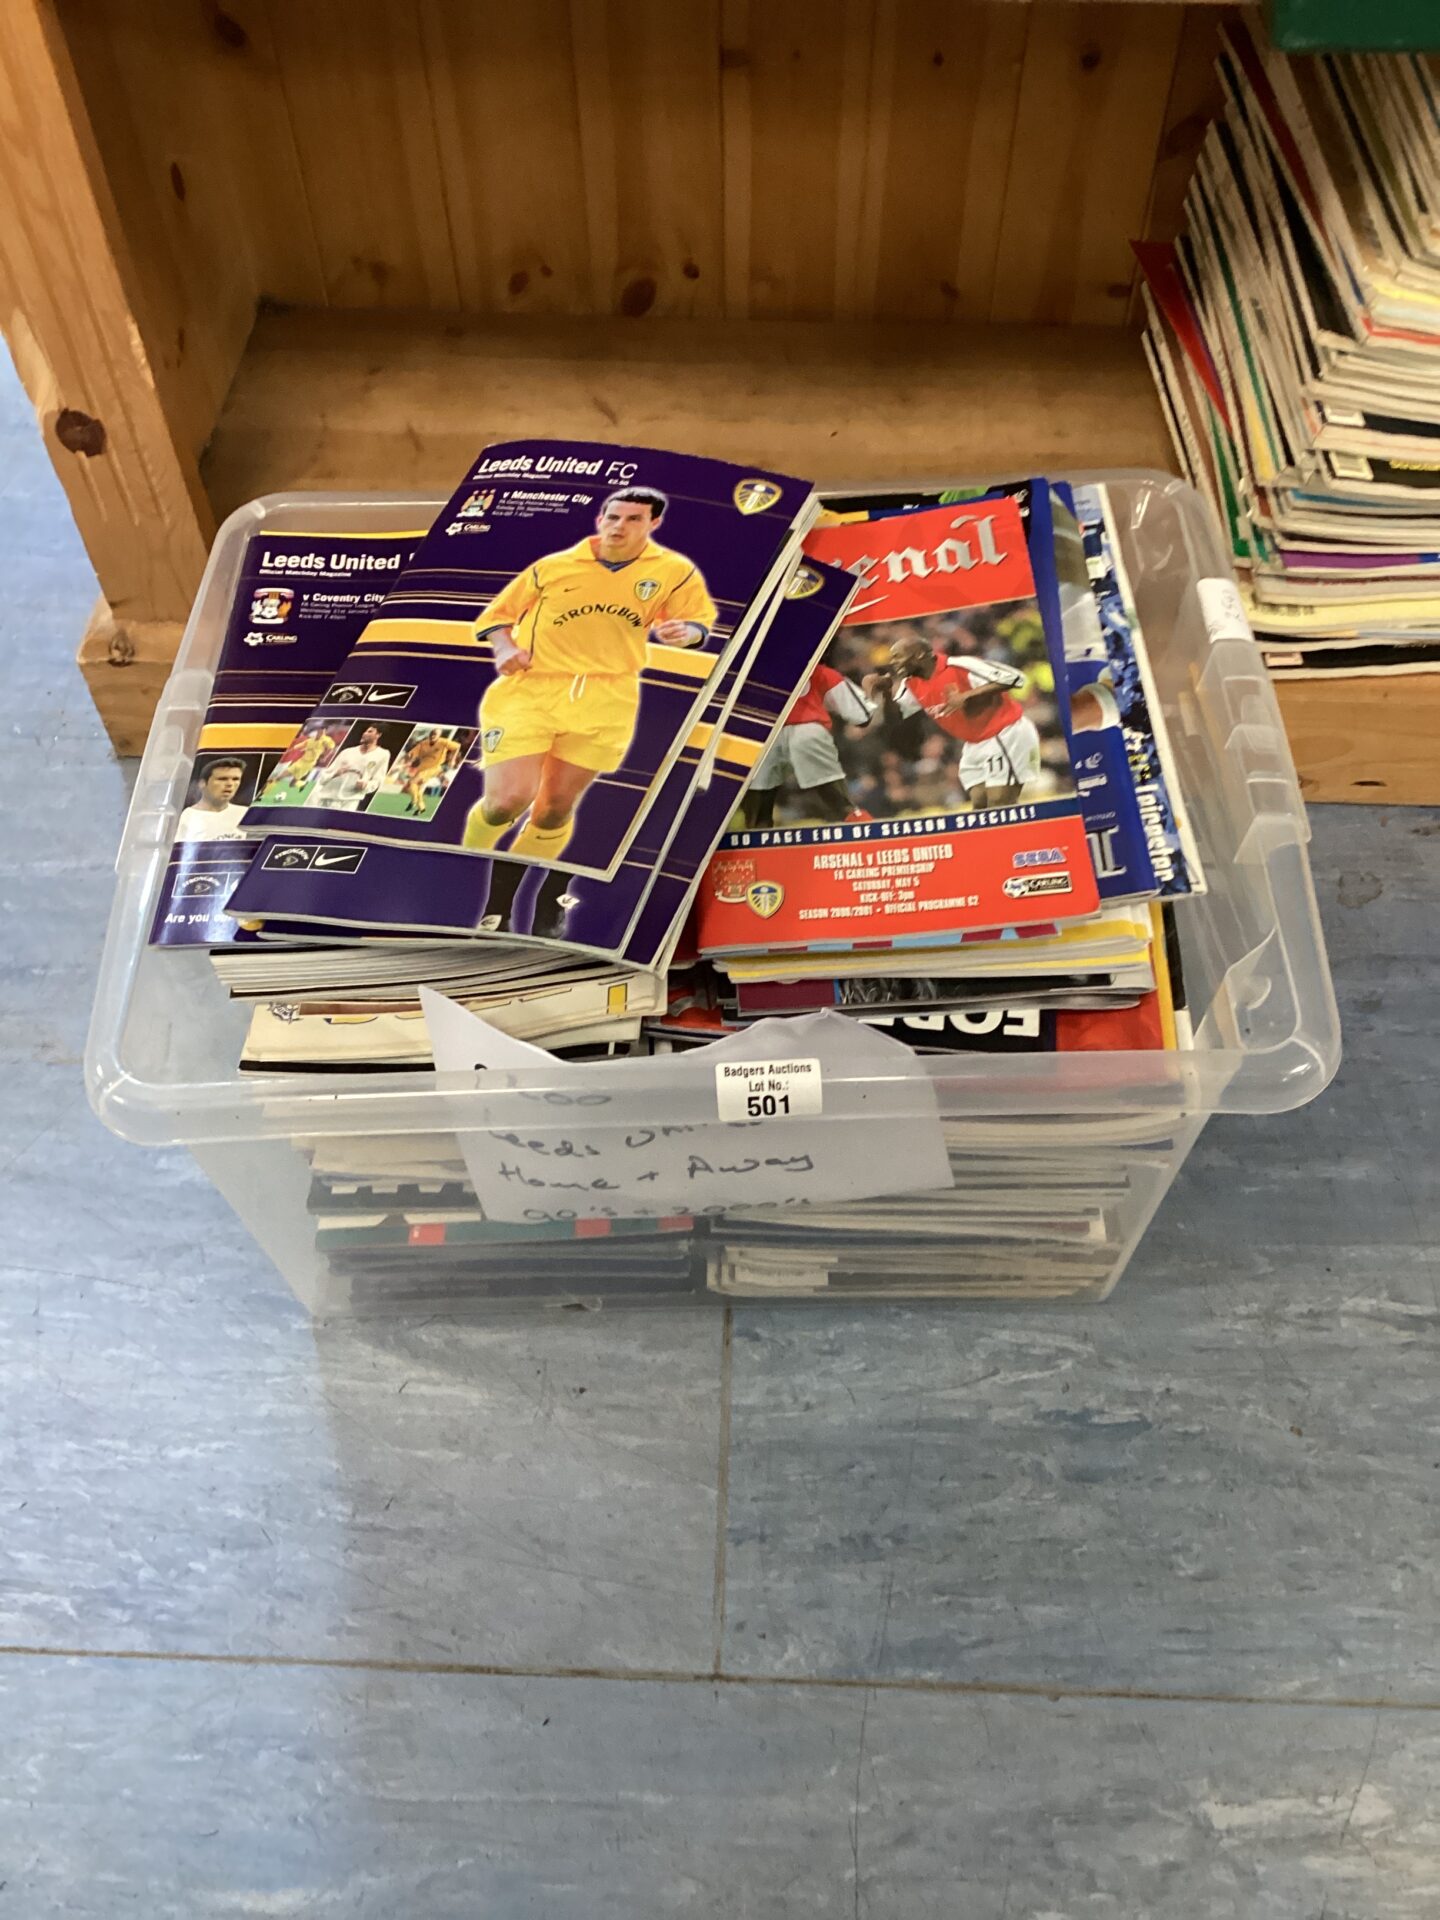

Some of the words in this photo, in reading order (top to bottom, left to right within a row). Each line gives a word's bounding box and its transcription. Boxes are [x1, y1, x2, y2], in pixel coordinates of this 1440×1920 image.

[478, 455, 534, 474] Leeds
[535, 456, 604, 476] United
[605, 461, 638, 479] FC
[503, 491, 509, 499] v
[511, 490, 571, 503] Manchester
[571, 494, 593, 505] City
[262, 551, 326, 569] Leeds
[330, 553, 401, 571] United
[829, 515, 1008, 589] enal
[302, 593, 311, 601] v
[312, 592, 361, 604] Coventry
[364, 593, 386, 603] City
[552, 603, 642, 628] STRONGBOW
[986, 757, 1004, 773] 11
[761, 831, 803, 845] PAGE
[812, 828, 843, 842] END
[852, 825, 872, 839] OF
[881, 818, 947, 837] SEASON
[955, 806, 1036, 829] SPECIAL!
[813, 851, 865, 870] ARSENAL
[876, 848, 910, 865] LEEDS
[912, 844, 954, 862] UNITED
[846, 866, 880, 880] CARLING
[881, 862, 936, 878] PREMIERSHIP
[164, 913, 186, 924] Are
[188, 914, 210, 925] you
[799, 908, 829, 921] SEASON
[918, 896, 966, 912] PROGRAMME
[724, 1065, 765, 1078] Badgers
[768, 1063, 812, 1075] Auctions
[748, 1081, 765, 1093] Lot
[747, 1094, 790, 1117] 501
[499, 1161, 620, 1192] Home
[687, 1153, 814, 1180] Away
